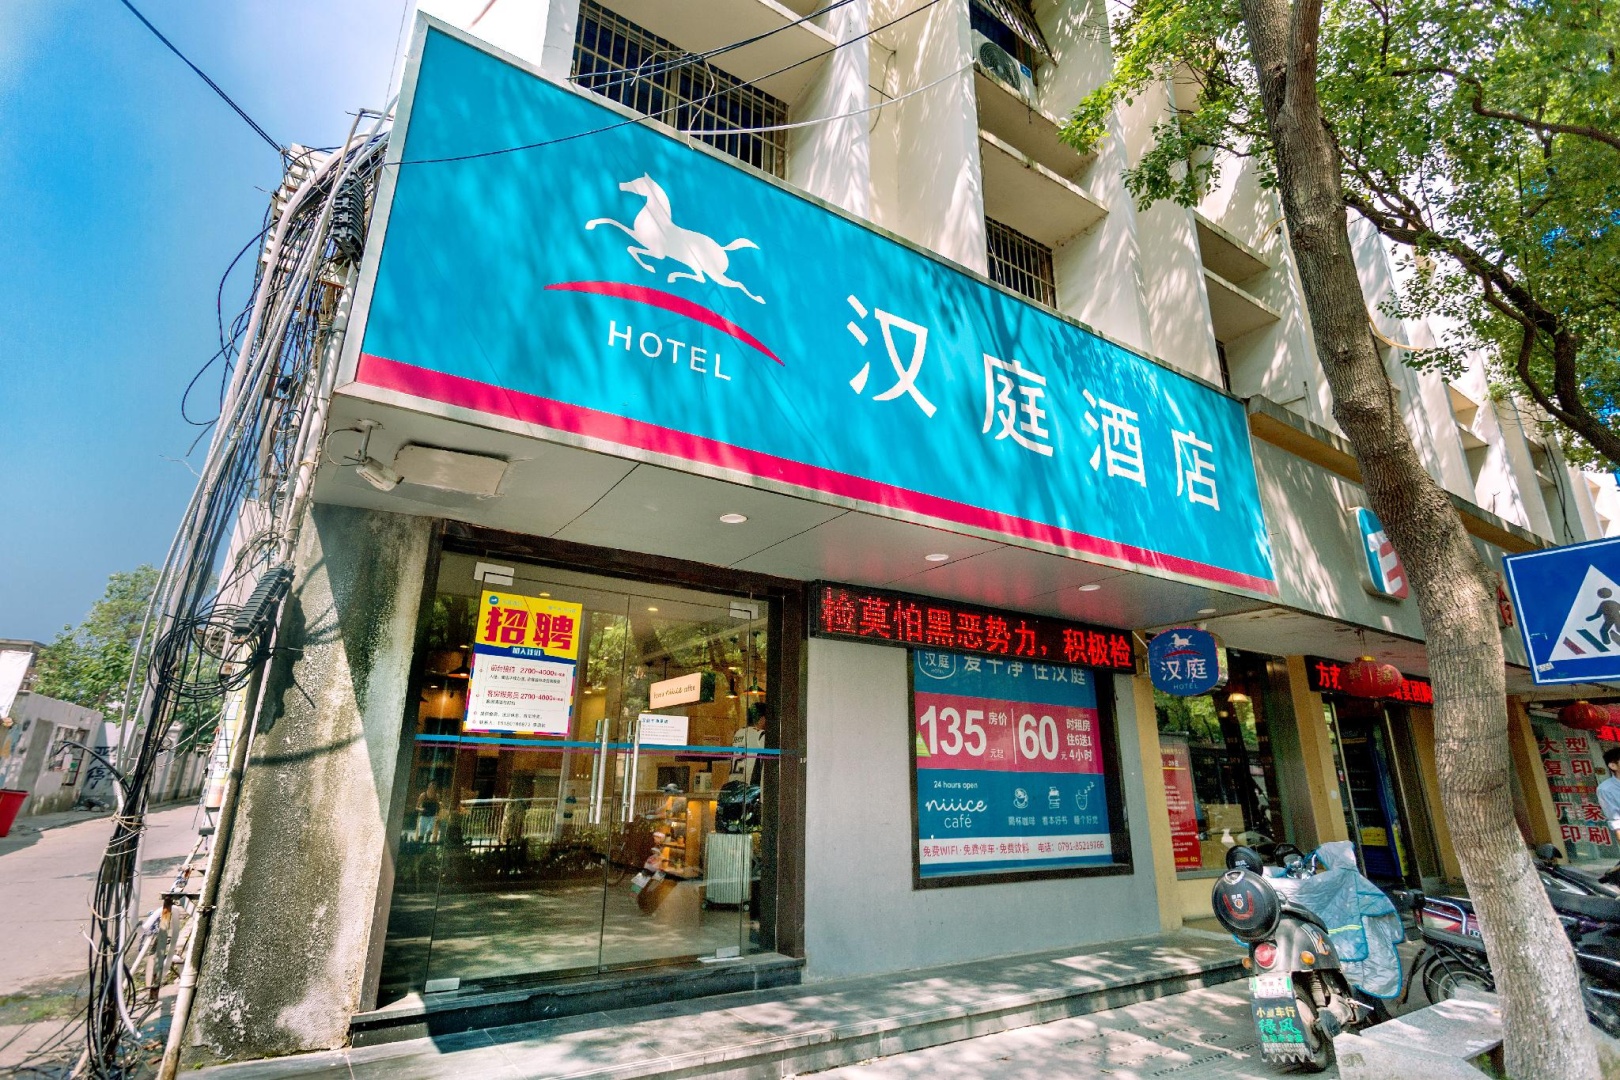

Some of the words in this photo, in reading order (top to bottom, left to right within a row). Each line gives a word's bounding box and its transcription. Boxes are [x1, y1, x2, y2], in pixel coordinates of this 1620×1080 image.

[608, 320, 731, 381] HOTEL
[846, 294, 1221, 511] 汉庭酒店
[484, 606, 574, 650] 招聘
[512, 646, 541, 657] 加入我们
[925, 651, 950, 668] 汉庭
[1161, 658, 1208, 681] 汉庭
[988, 712, 1008, 726] 房价
[1066, 718, 1090, 732] 时租房
[920, 705, 987, 756] 135
[1018, 714, 1059, 760] 60
[1066, 733, 1092, 746] 住6送1
[1540, 737, 1589, 754] 大型
[990, 748, 1004, 758] 元起
[1069, 749, 1092, 761] 4小时
[1544, 760, 1593, 776] 复印
[933, 780, 941, 788] 24
[943, 781, 961, 789] hours
[963, 782, 978, 790] open
[925, 798, 987, 812] niiice
[1556, 802, 1605, 821] 厂家
[944, 813, 972, 829] café
[1561, 825, 1611, 844] 印刷
